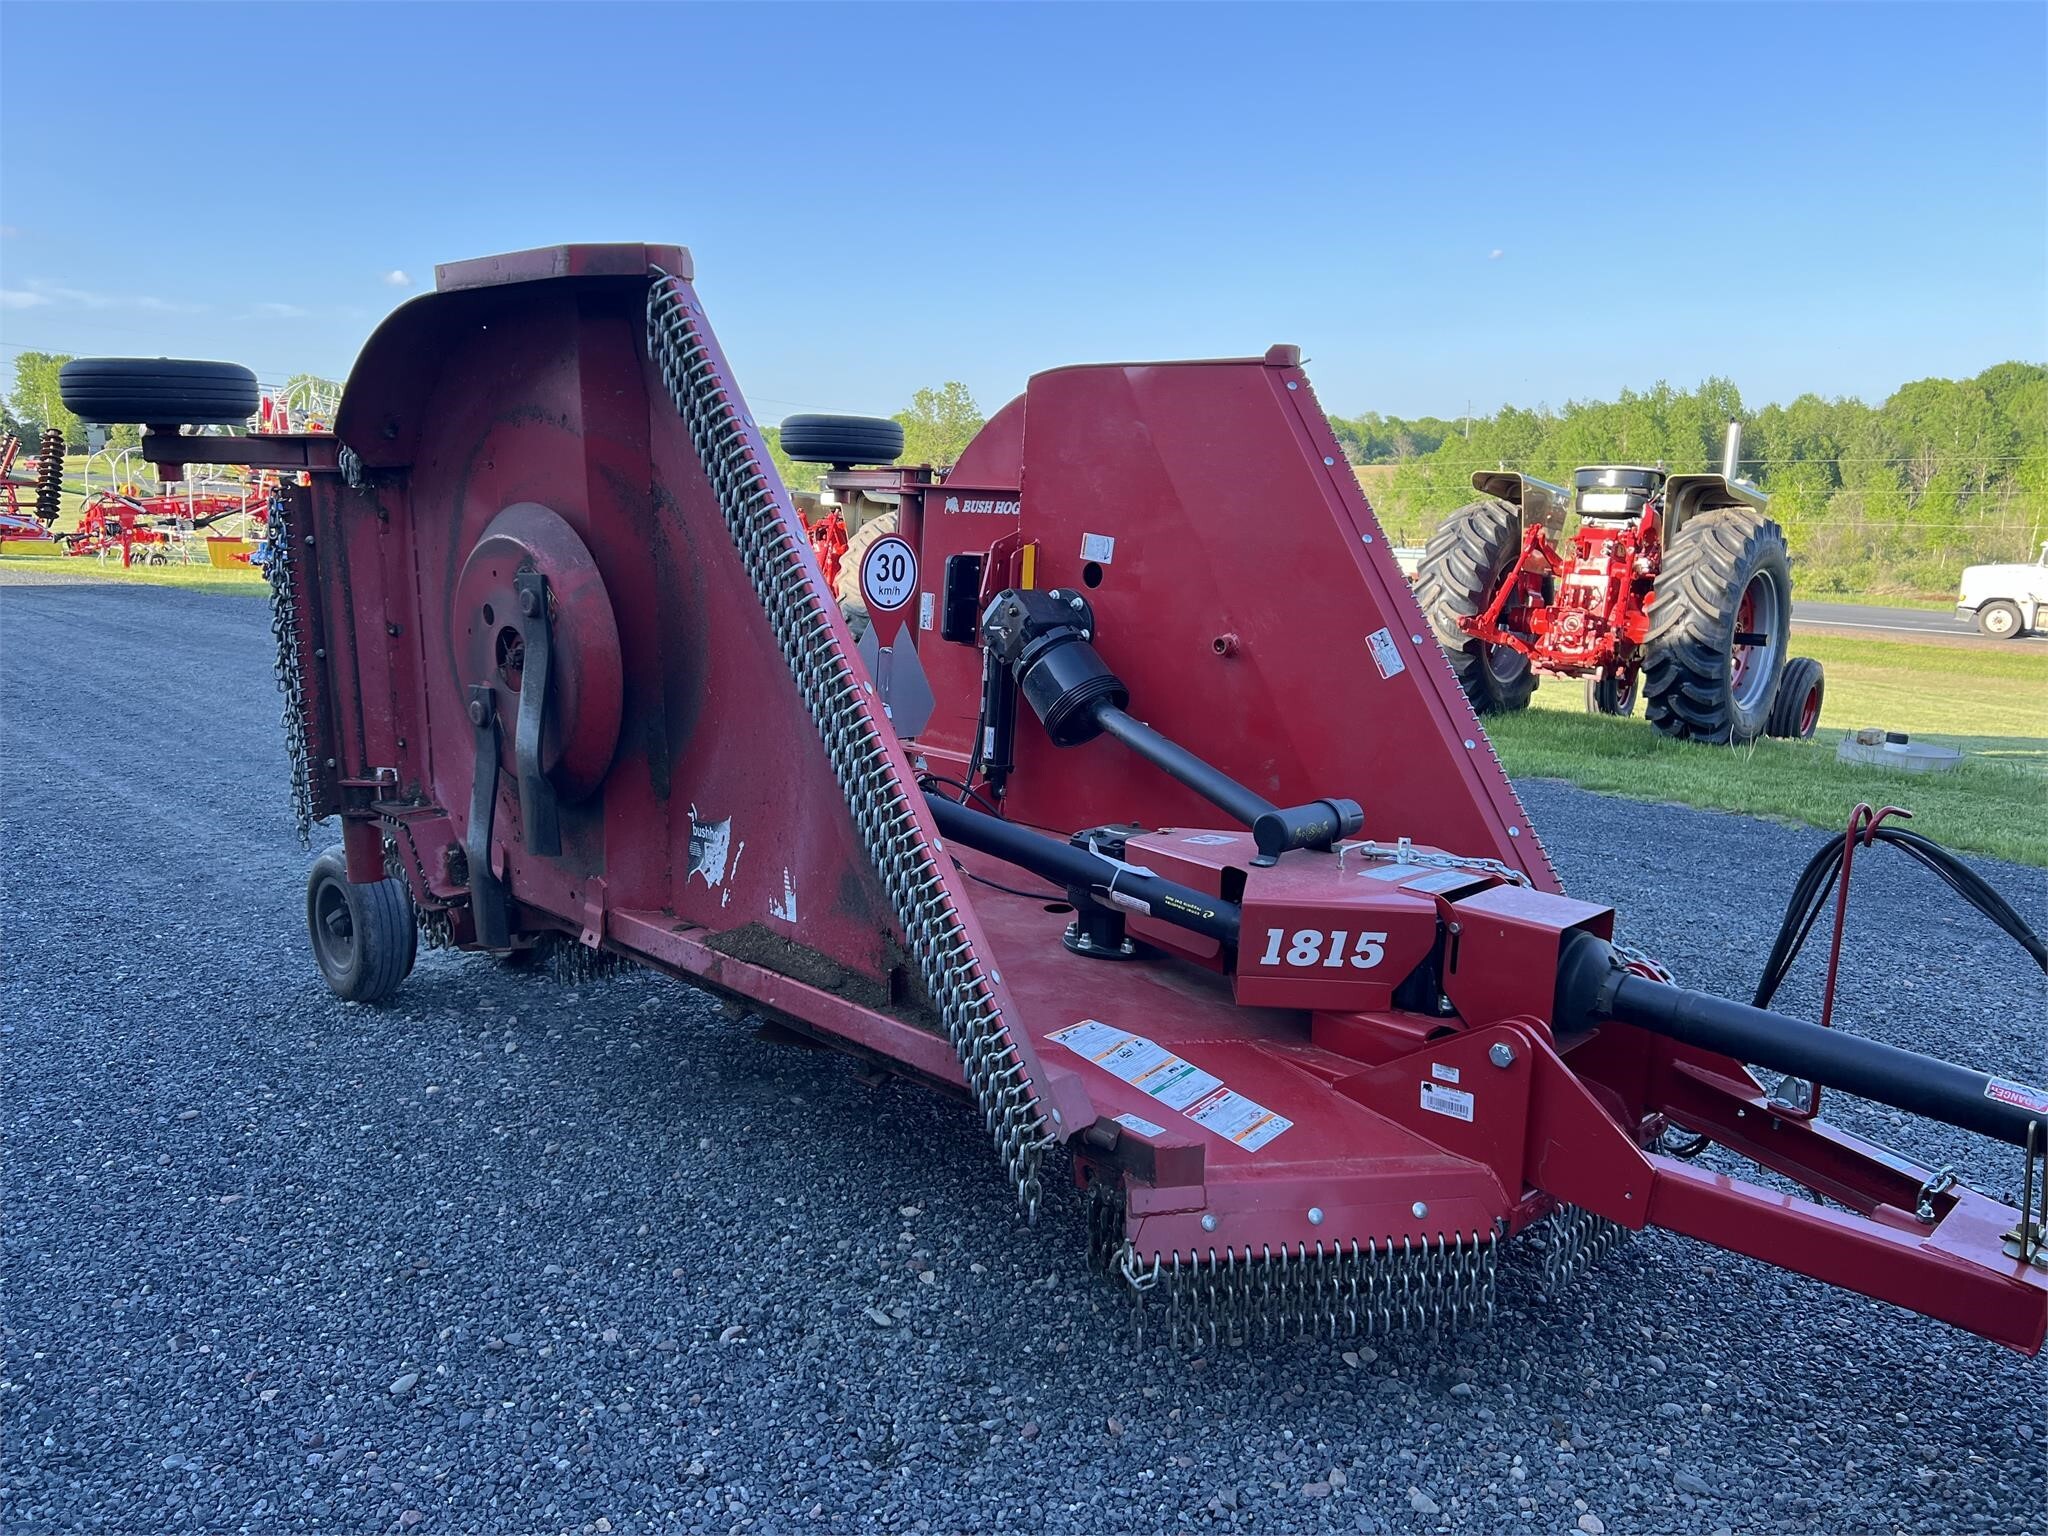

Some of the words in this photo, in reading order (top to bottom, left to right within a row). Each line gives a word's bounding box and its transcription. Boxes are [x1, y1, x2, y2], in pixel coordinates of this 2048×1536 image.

[962, 500, 994, 513] BUSH
[993, 501, 1021, 514] HOG
[876, 553, 905, 582] 30
[878, 585, 901, 595] km/h
[692, 823, 722, 841] bushho
[1259, 928, 1388, 969] 1815
